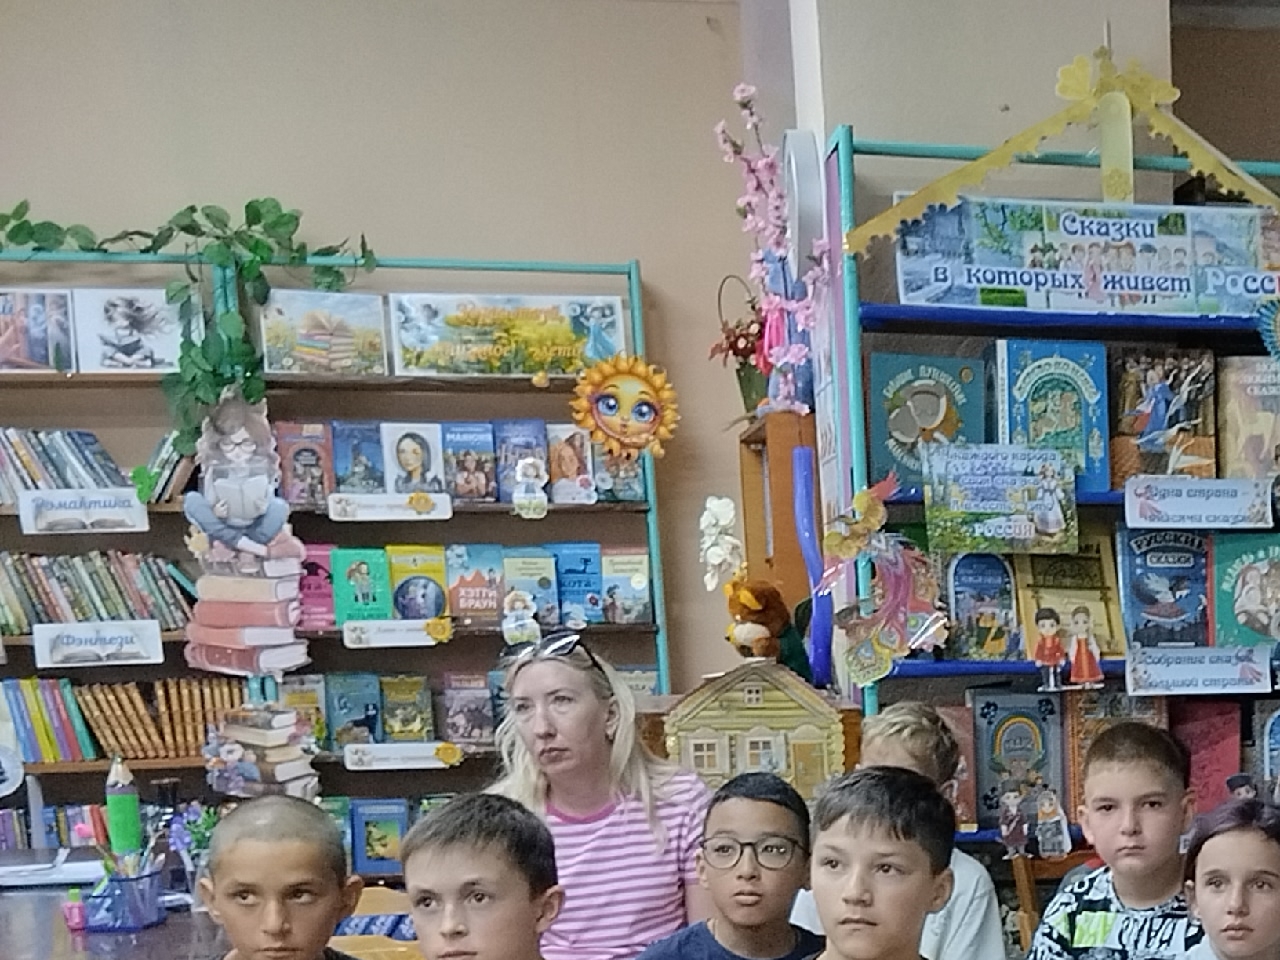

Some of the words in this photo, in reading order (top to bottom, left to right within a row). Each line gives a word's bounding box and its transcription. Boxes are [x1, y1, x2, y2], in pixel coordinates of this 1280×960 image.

[1061, 215, 1157, 242] Сказки
[932, 265, 950, 284] в
[965, 265, 1085, 292] которых
[1102, 272, 1192, 294] живет
[1186, 487, 1238, 501] страна
[32, 496, 134, 512] Романтика
[458, 598, 497, 610] БРАУН
[59, 632, 137, 651] Фэнтези
